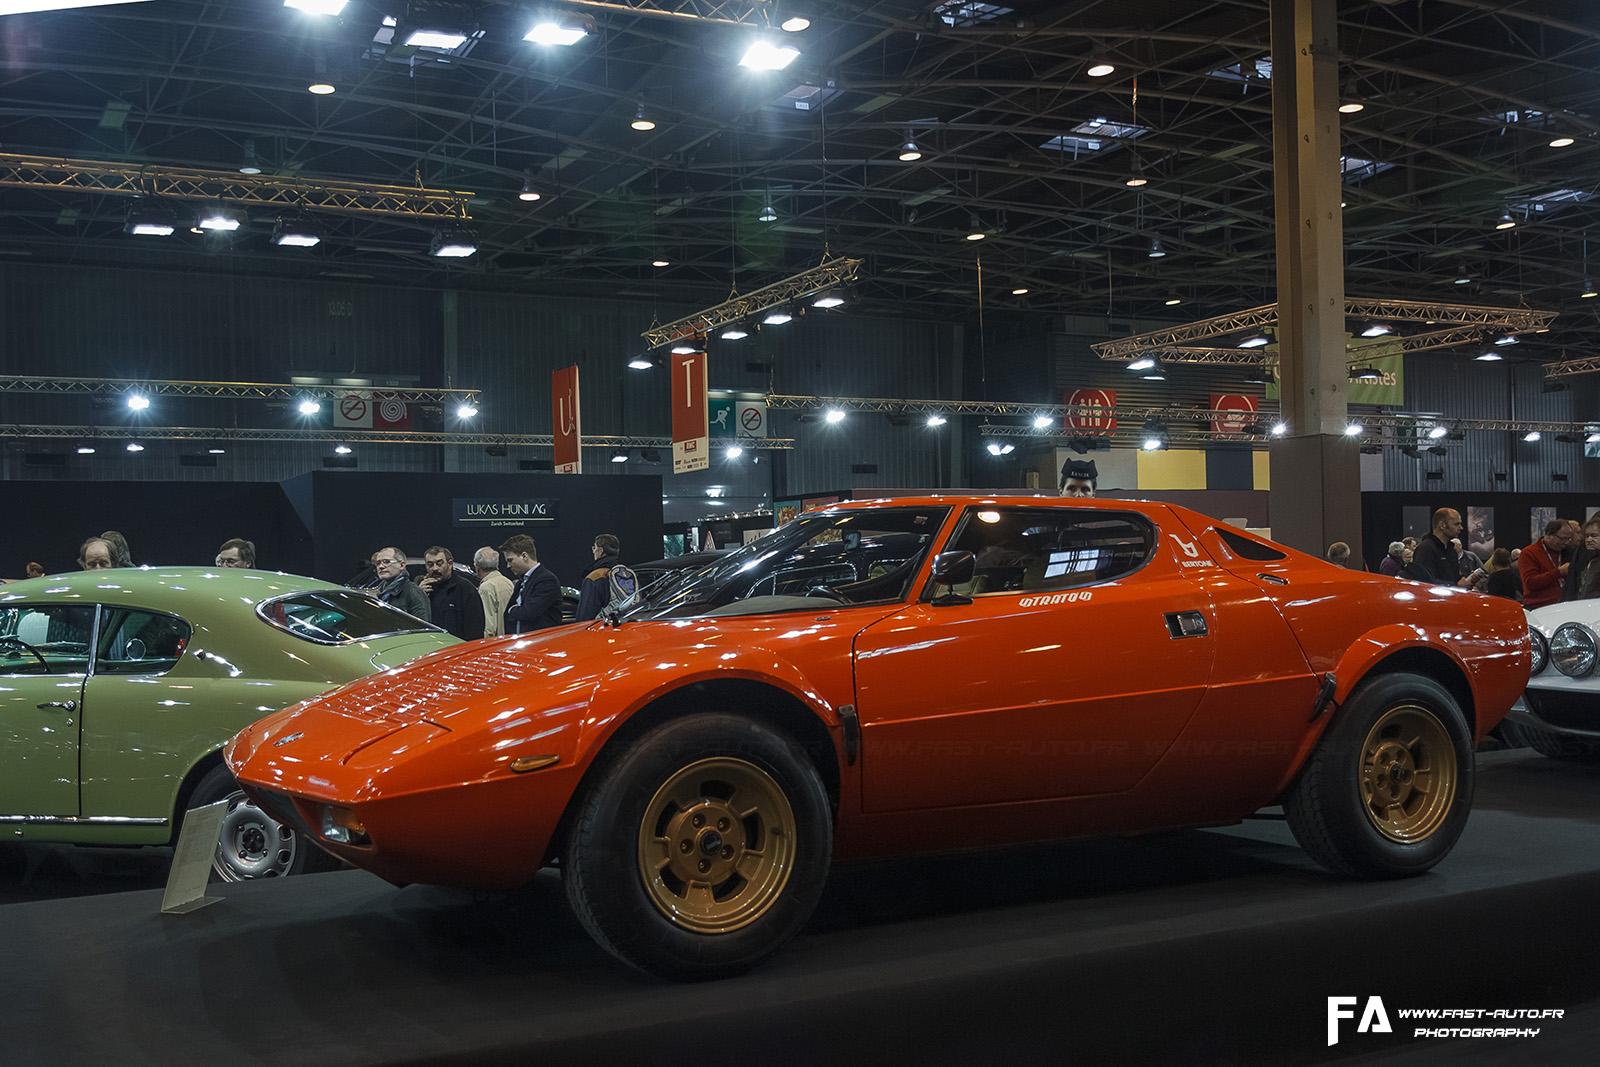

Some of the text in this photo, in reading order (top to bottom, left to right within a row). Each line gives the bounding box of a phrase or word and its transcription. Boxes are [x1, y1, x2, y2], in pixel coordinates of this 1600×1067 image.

[682, 359, 695, 408] T
[559, 395, 572, 437] U
[467, 504, 499, 515] LUKAS
[532, 504, 546, 515] AG
[1181, 560, 1214, 568] BERTONE
[1019, 591, 1093, 607] STRATOS
